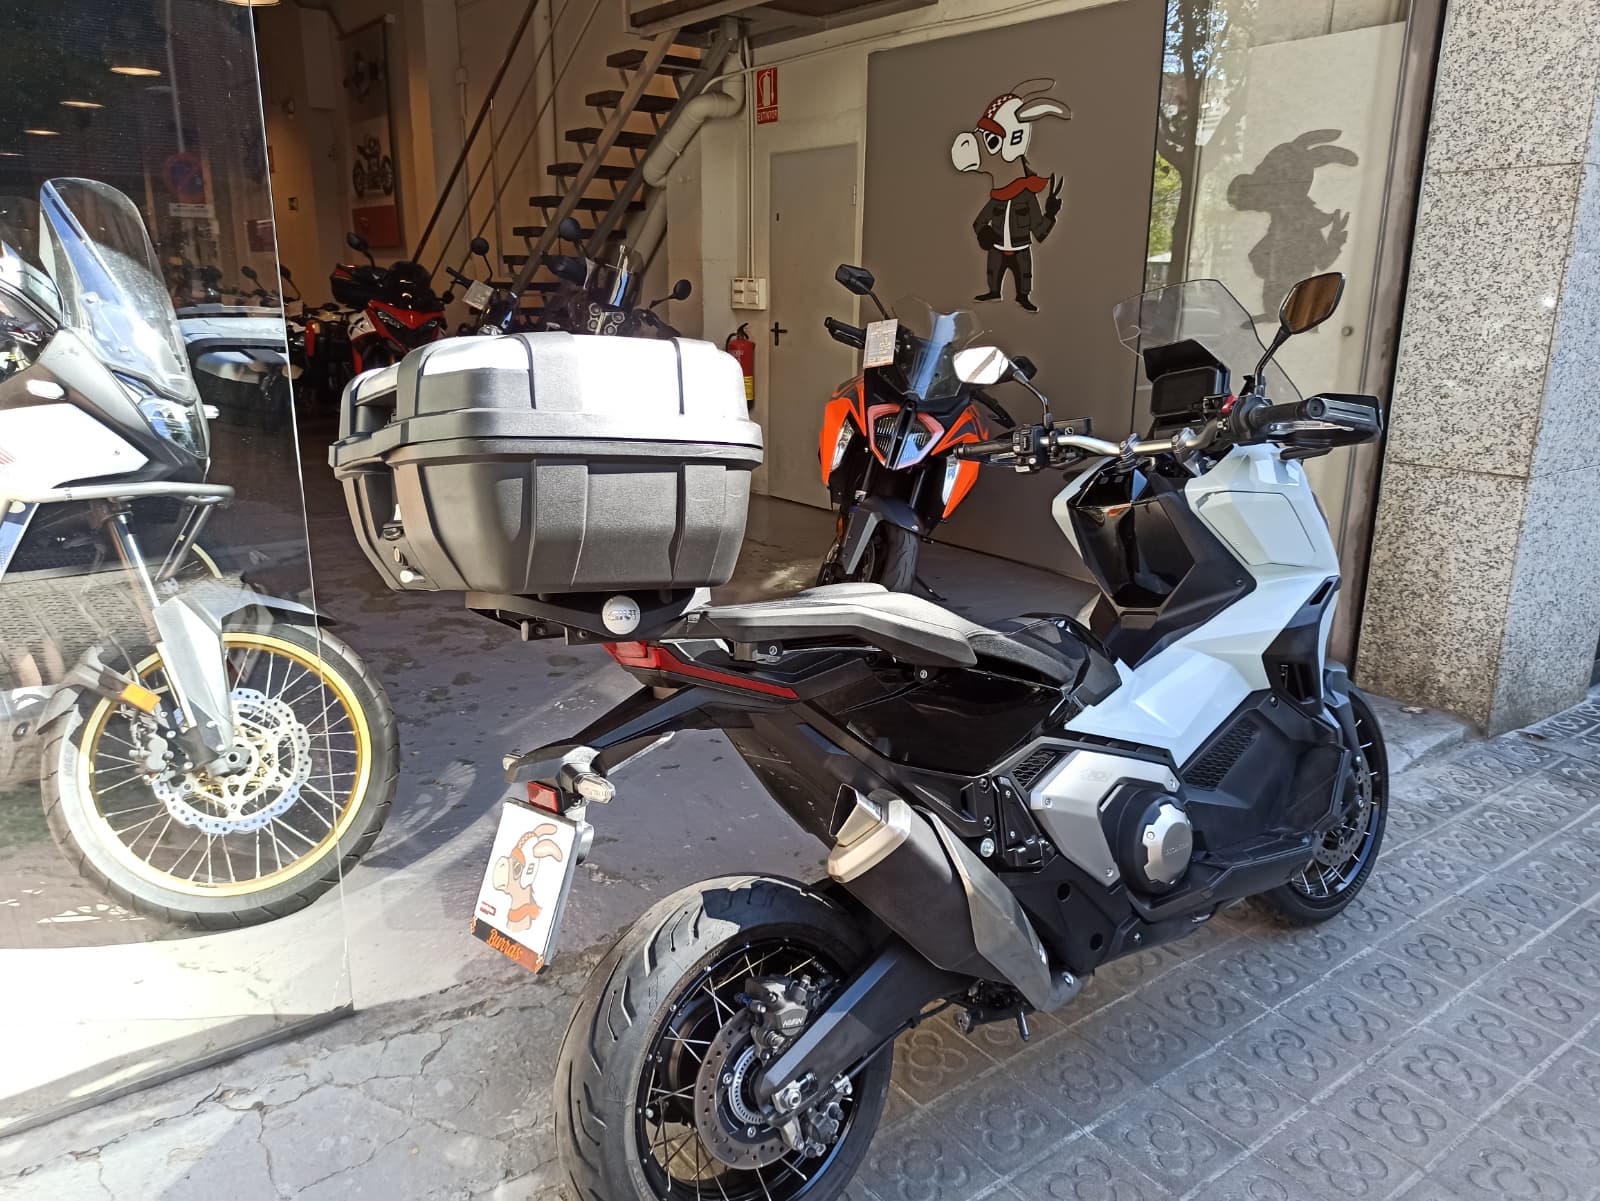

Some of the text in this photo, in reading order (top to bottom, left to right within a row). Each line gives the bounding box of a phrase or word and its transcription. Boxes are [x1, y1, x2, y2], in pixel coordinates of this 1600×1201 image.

[757, 110, 777, 122] EXTINTOR
[1010, 129, 1024, 146] B
[526, 863, 535, 875] B
[486, 928, 523, 961] Burras
